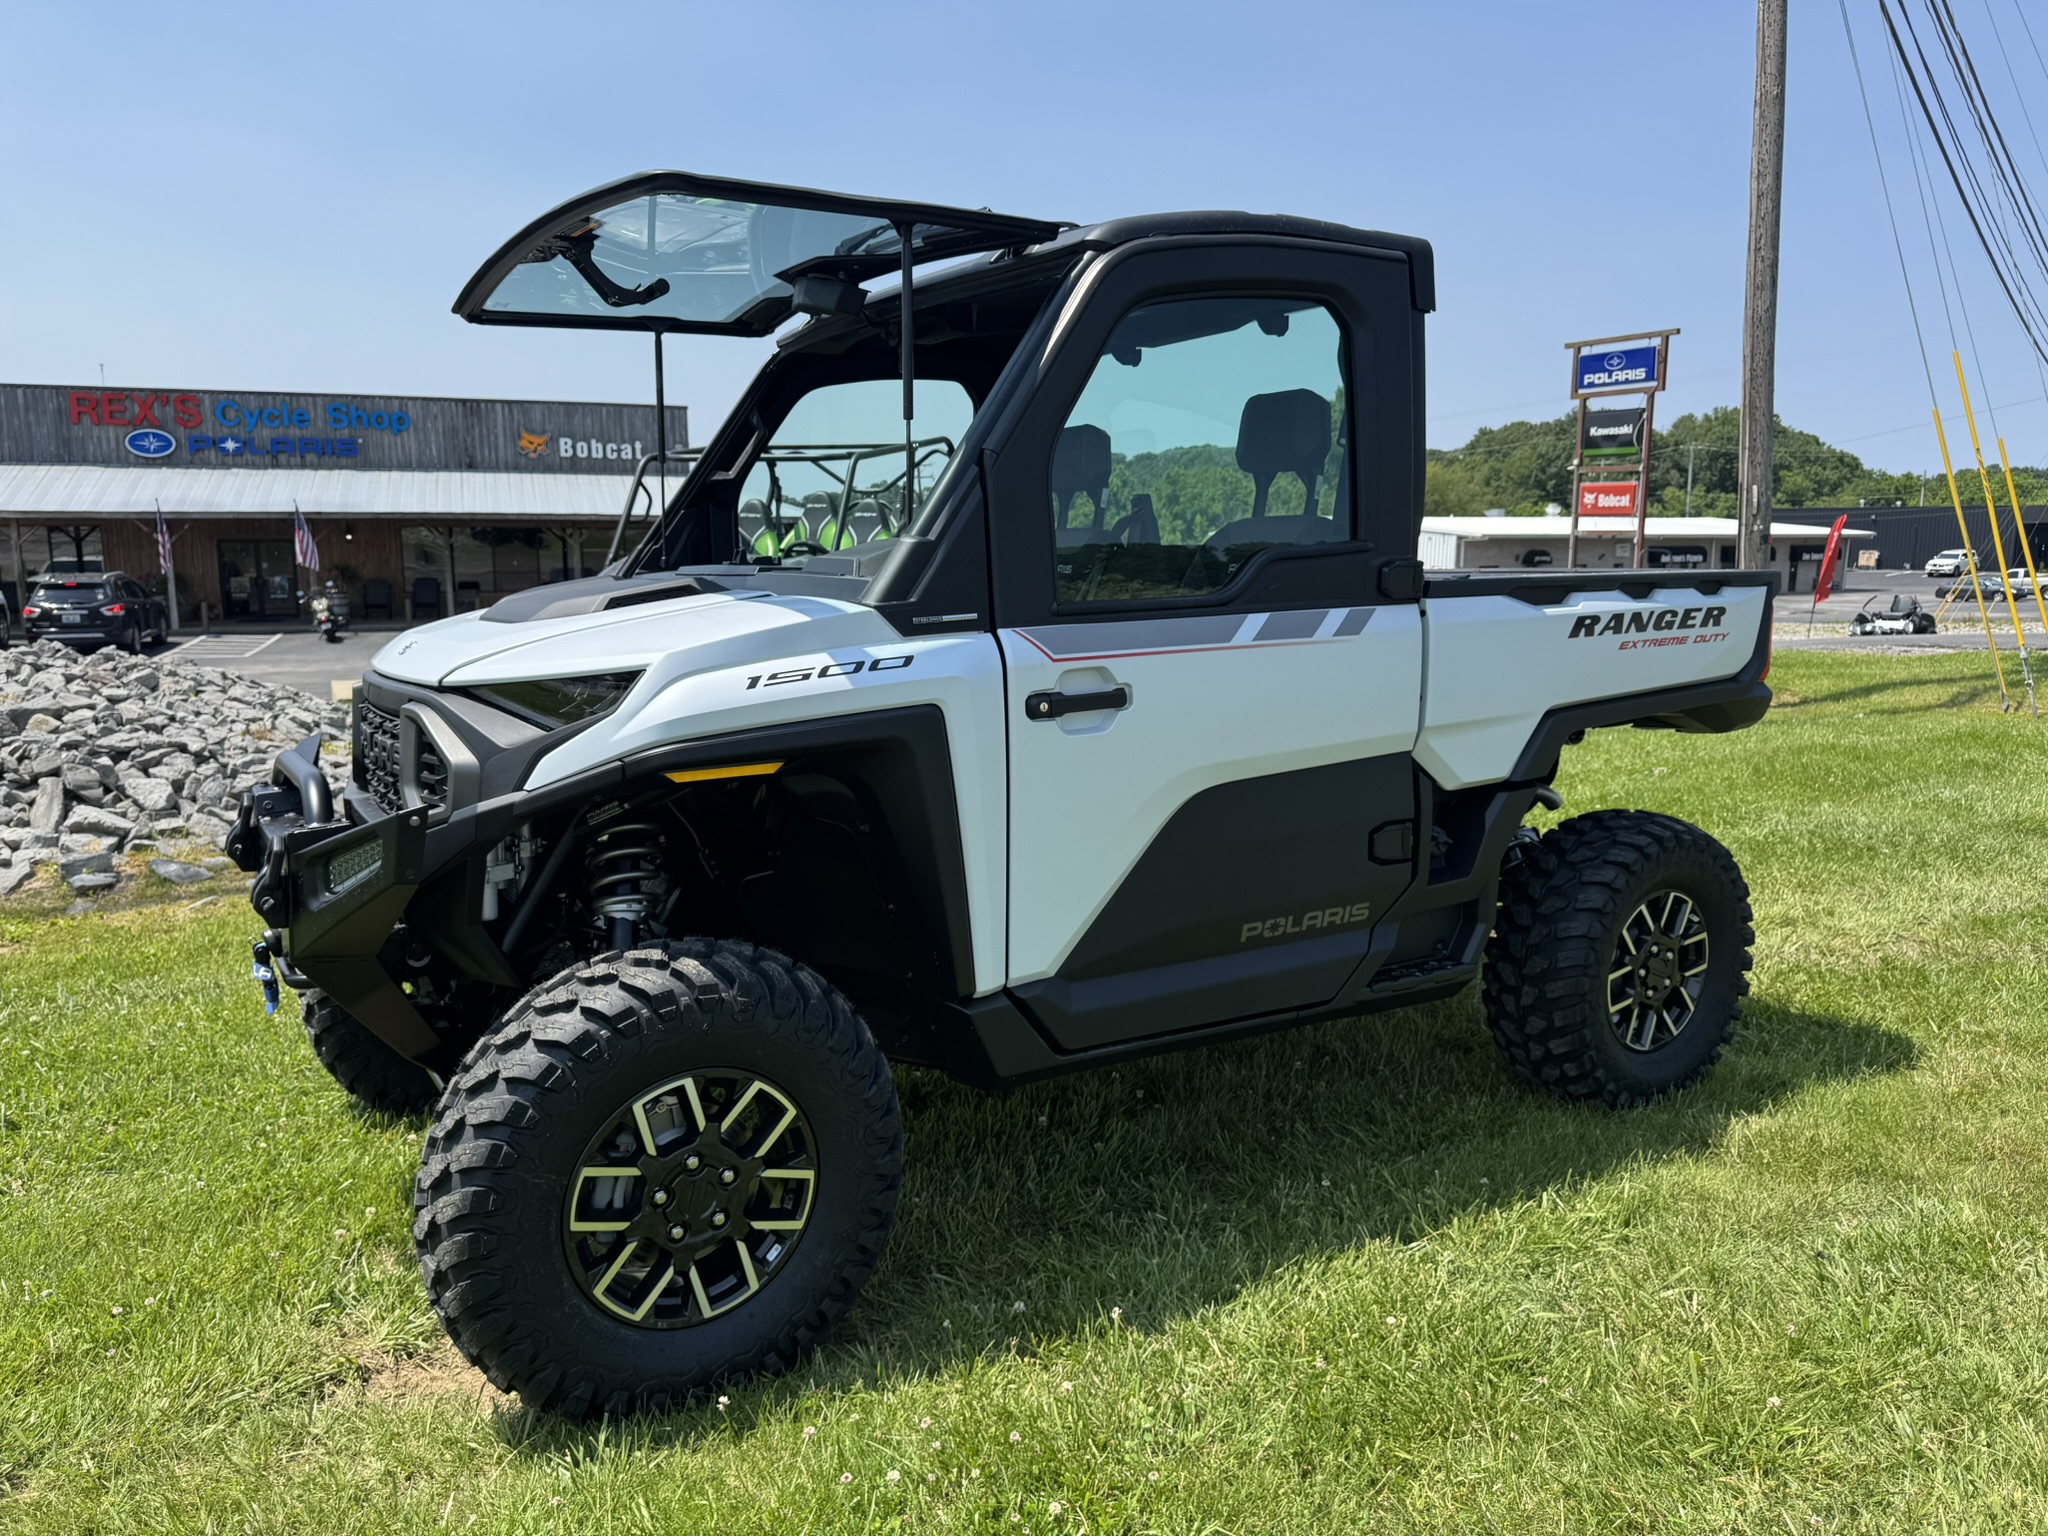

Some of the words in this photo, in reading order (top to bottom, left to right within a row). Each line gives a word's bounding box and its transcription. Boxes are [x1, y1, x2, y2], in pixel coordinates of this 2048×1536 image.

[1583, 368, 1647, 386] POLARIS
[68, 391, 203, 428] REX'S
[215, 401, 311, 433] Cycle
[327, 402, 411, 436] Shop
[1589, 424, 1633, 437] Kawasaki
[187, 435, 359, 458] POLARIS
[558, 437, 643, 460] Bobcat
[1597, 493, 1631, 508] Bobcat
[1568, 606, 1727, 639] RANGER
[1618, 636, 1690, 651] EXTREME
[1693, 632, 1730, 645] DUTY
[745, 654, 915, 690] 1500
[1240, 902, 1371, 943] POLARIS
